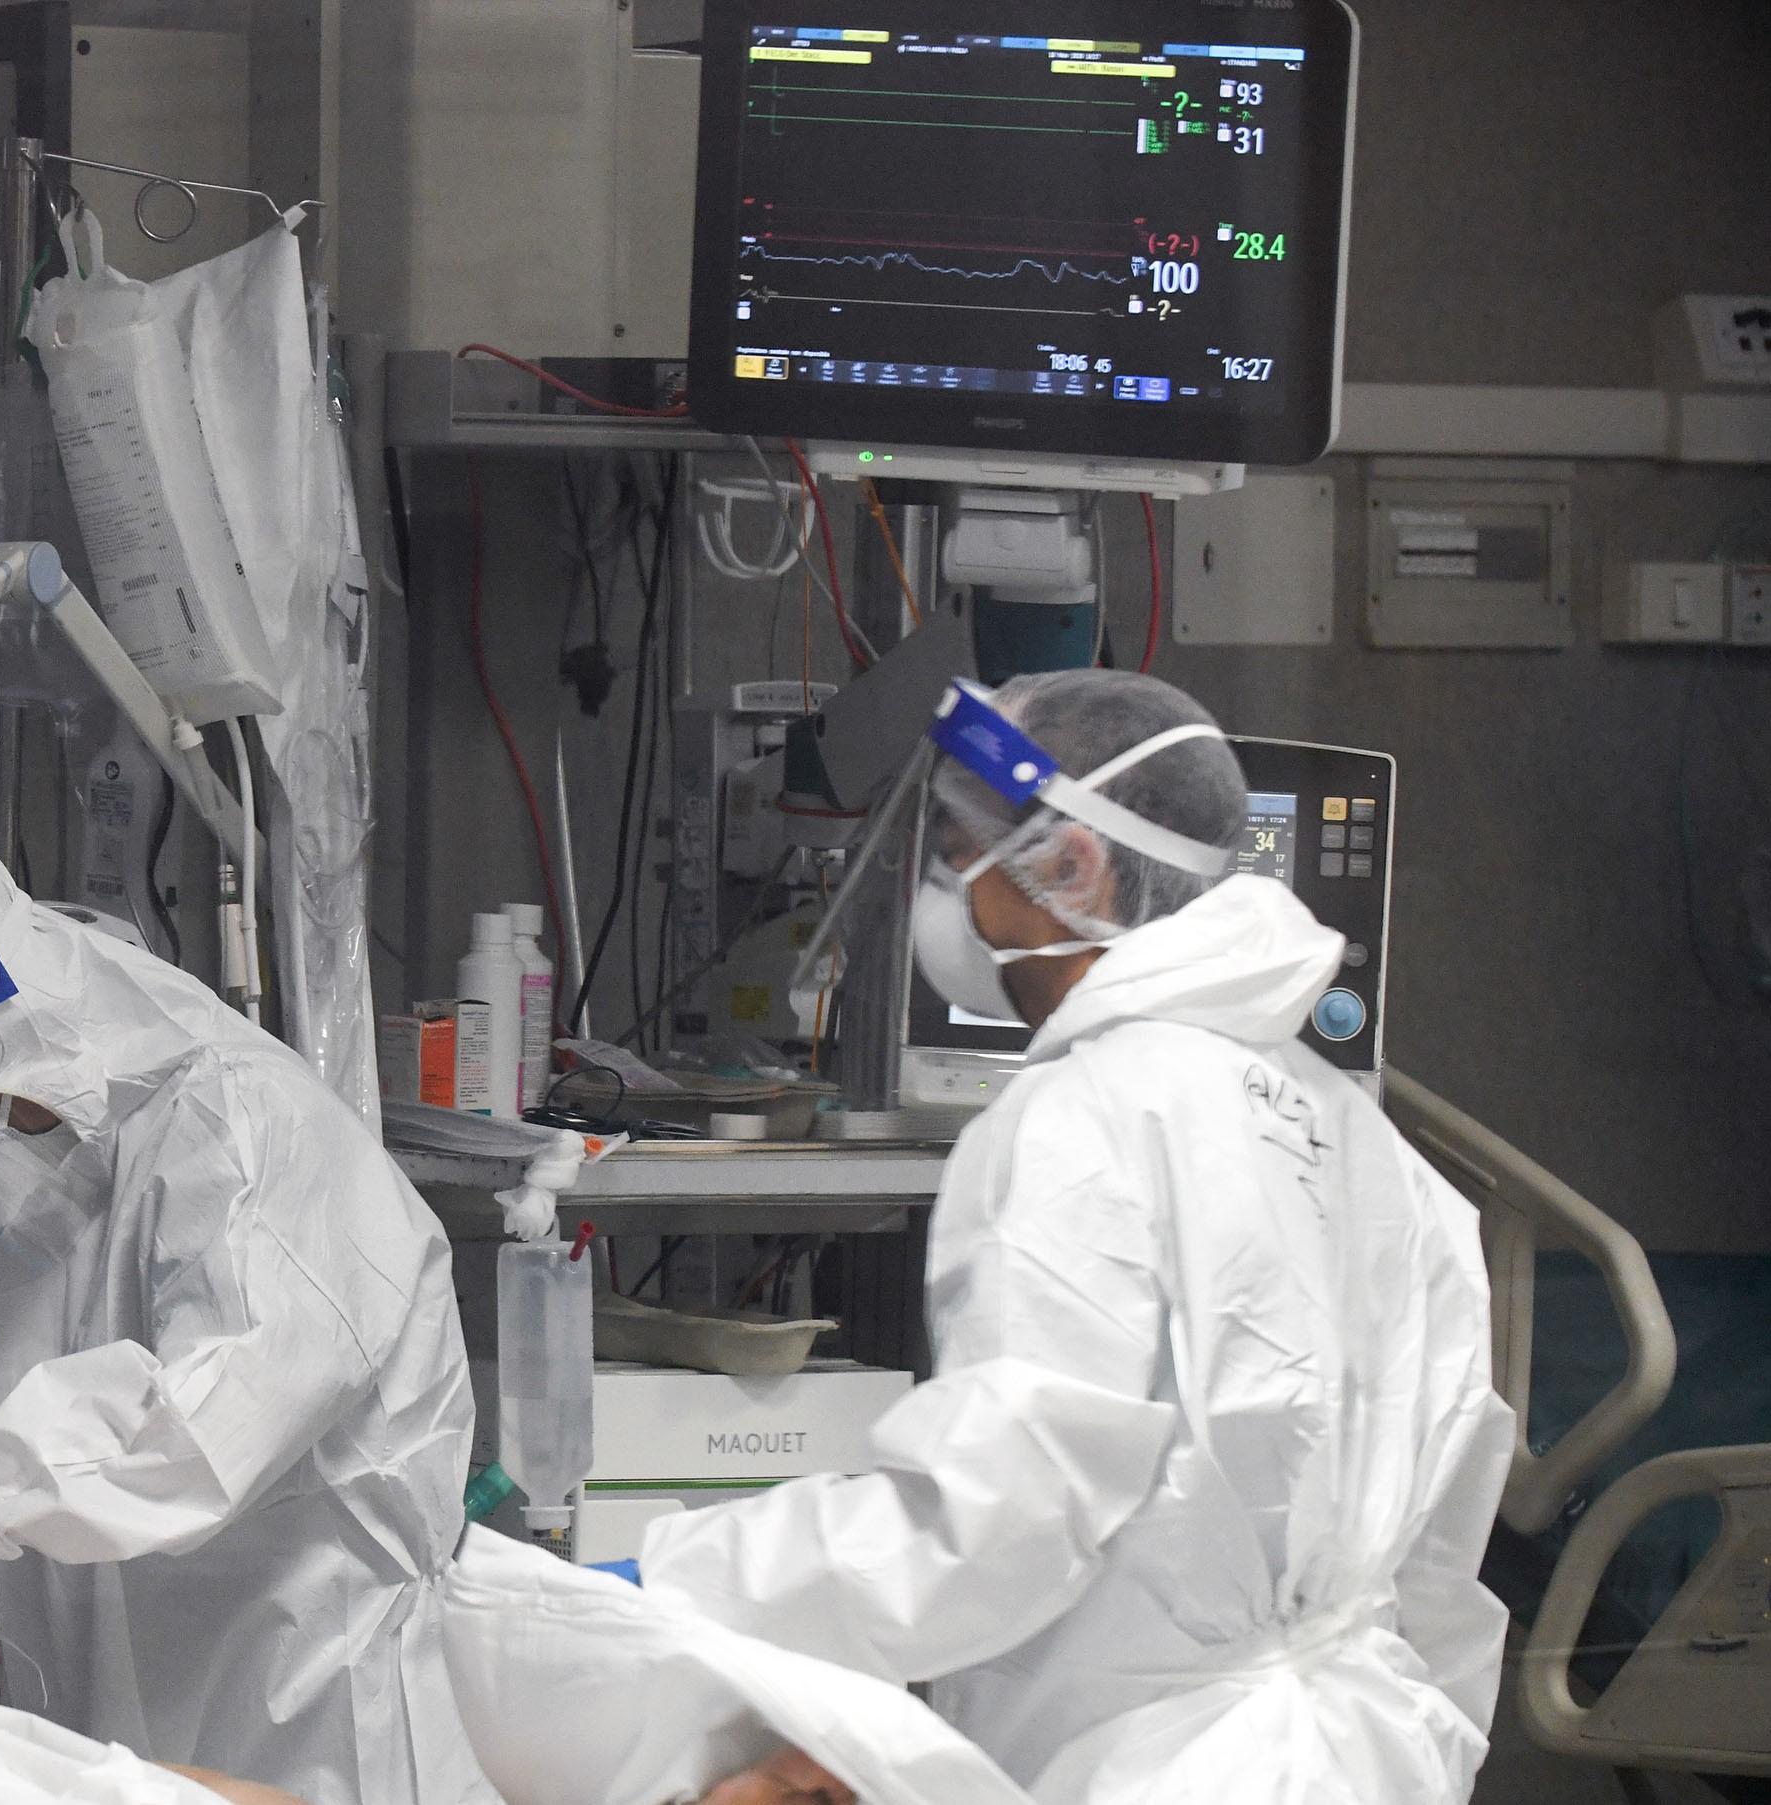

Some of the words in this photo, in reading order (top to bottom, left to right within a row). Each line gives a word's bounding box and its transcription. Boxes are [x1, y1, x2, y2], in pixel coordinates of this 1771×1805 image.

[1236, 82, 1263, 106] 93
[1233, 127, 1264, 155] 31
[1233, 232, 1286, 261] 28.4
[1148, 260, 1199, 294] 100
[1094, 358, 1112, 373] 45
[1221, 356, 1274, 381] 16:27
[1254, 831, 1275, 852] 34
[1275, 853, 1285, 863] 17
[1274, 868, 1285, 878] 12
[707, 1432, 807, 1456] MAQUET
